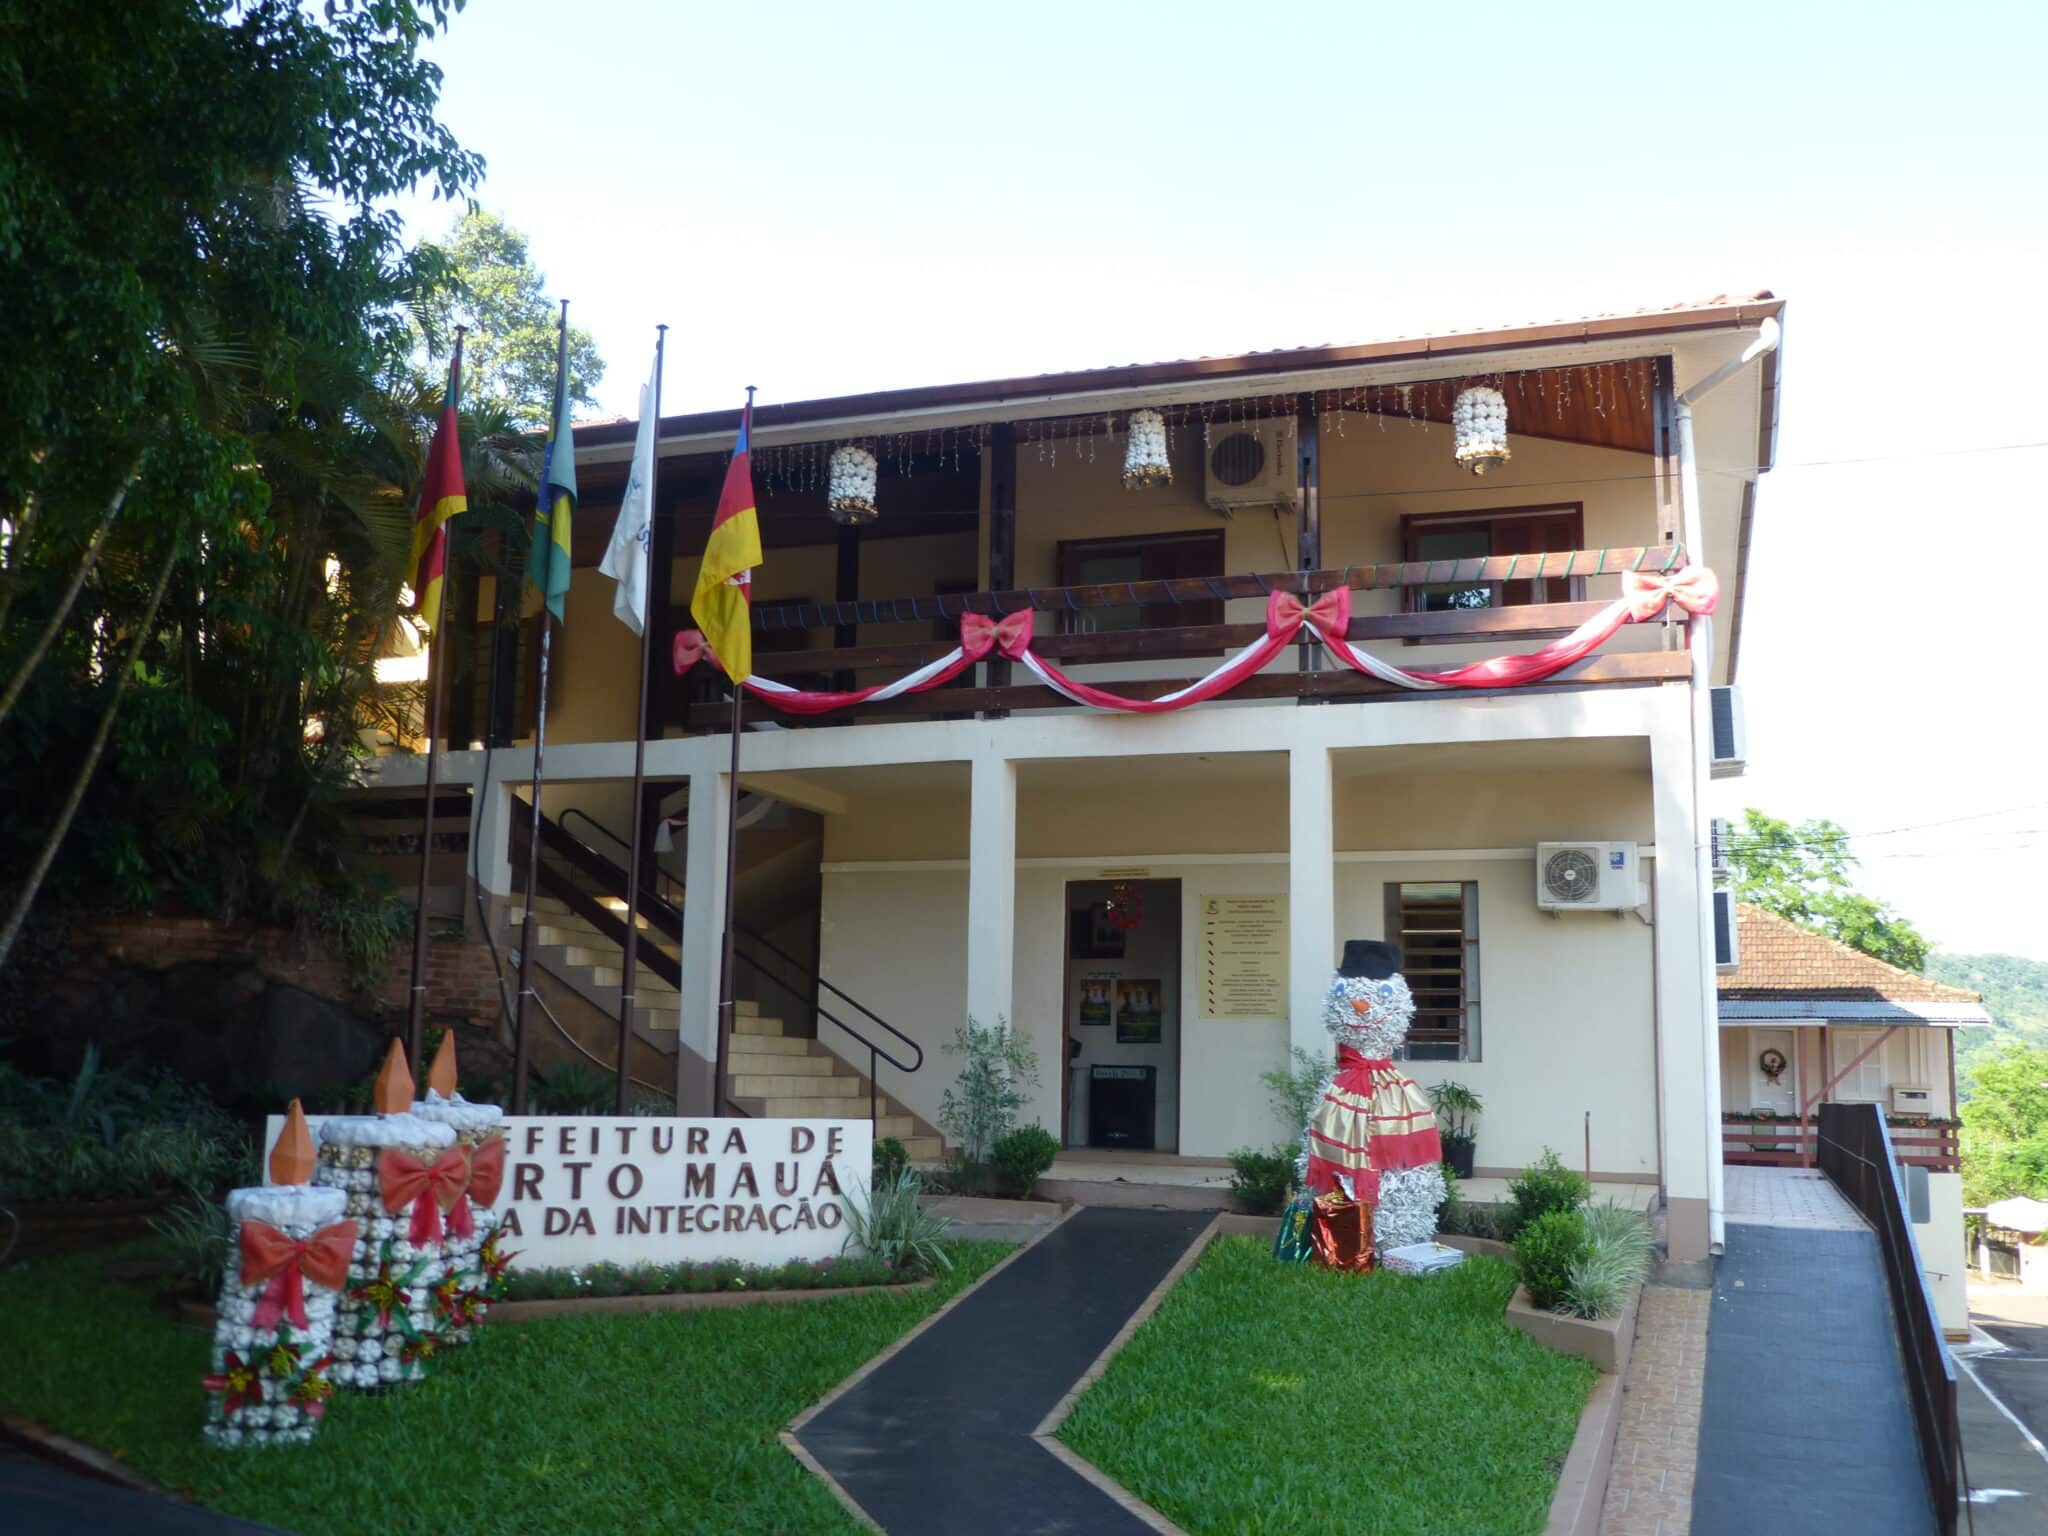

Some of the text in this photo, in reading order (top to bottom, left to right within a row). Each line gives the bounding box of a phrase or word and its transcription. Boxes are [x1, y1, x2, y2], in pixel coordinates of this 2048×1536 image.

[791, 1126, 844, 1154] DE
[513, 1155, 842, 1201] RTO MAUÁ
[543, 1207, 596, 1236] DA
[615, 1197, 843, 1234] INTEGRAÇÃO
